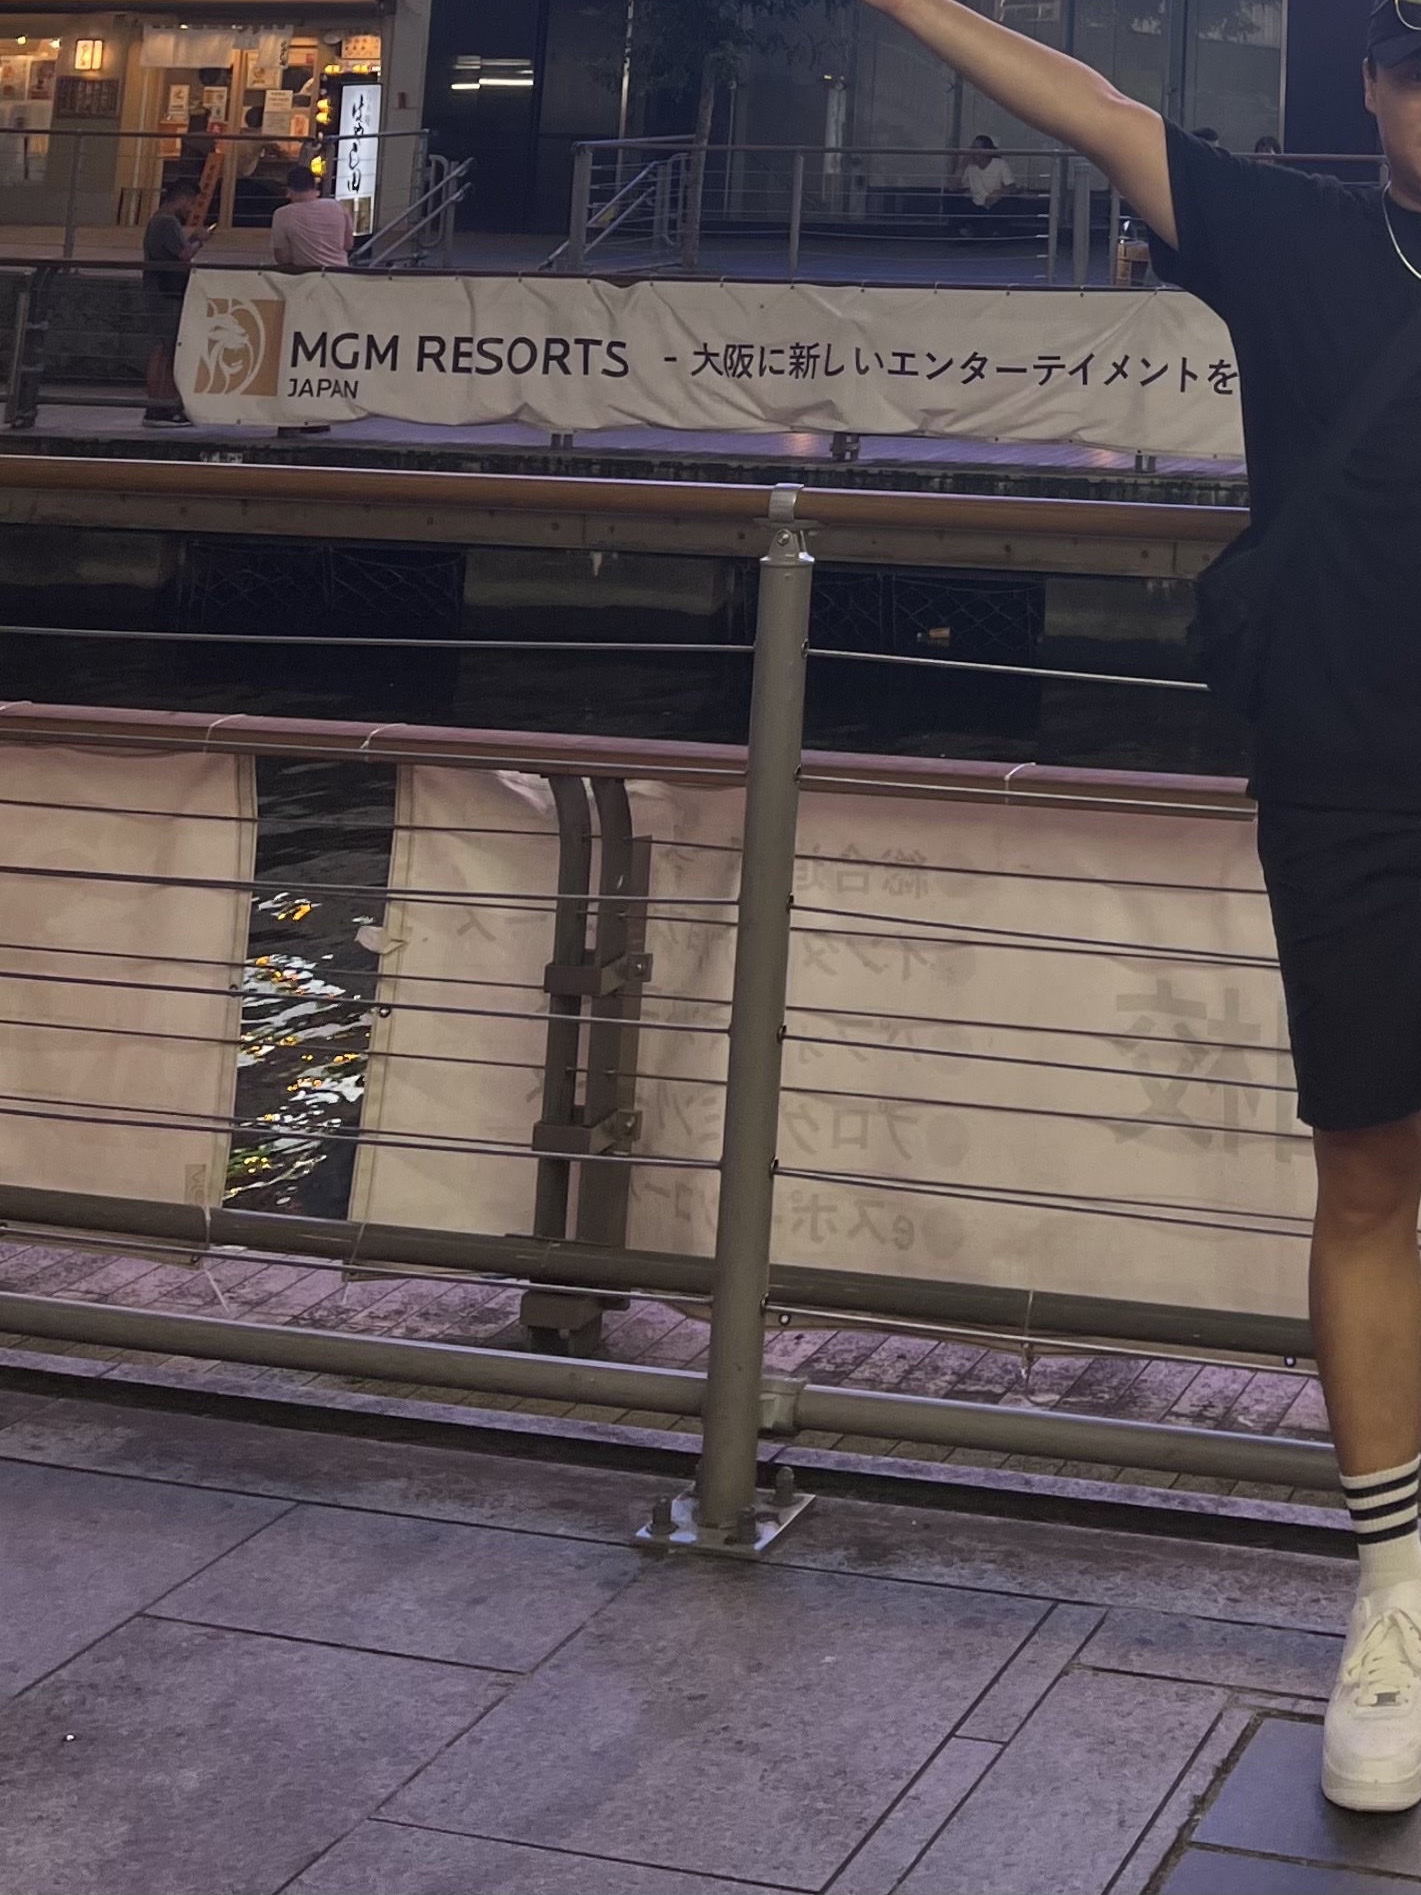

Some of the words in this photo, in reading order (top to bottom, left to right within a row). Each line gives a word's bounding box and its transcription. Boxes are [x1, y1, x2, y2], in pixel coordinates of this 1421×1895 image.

[291, 332, 398, 371] MGM
[416, 337, 629, 378] RESORTS
[288, 378, 360, 400] JAPAN
